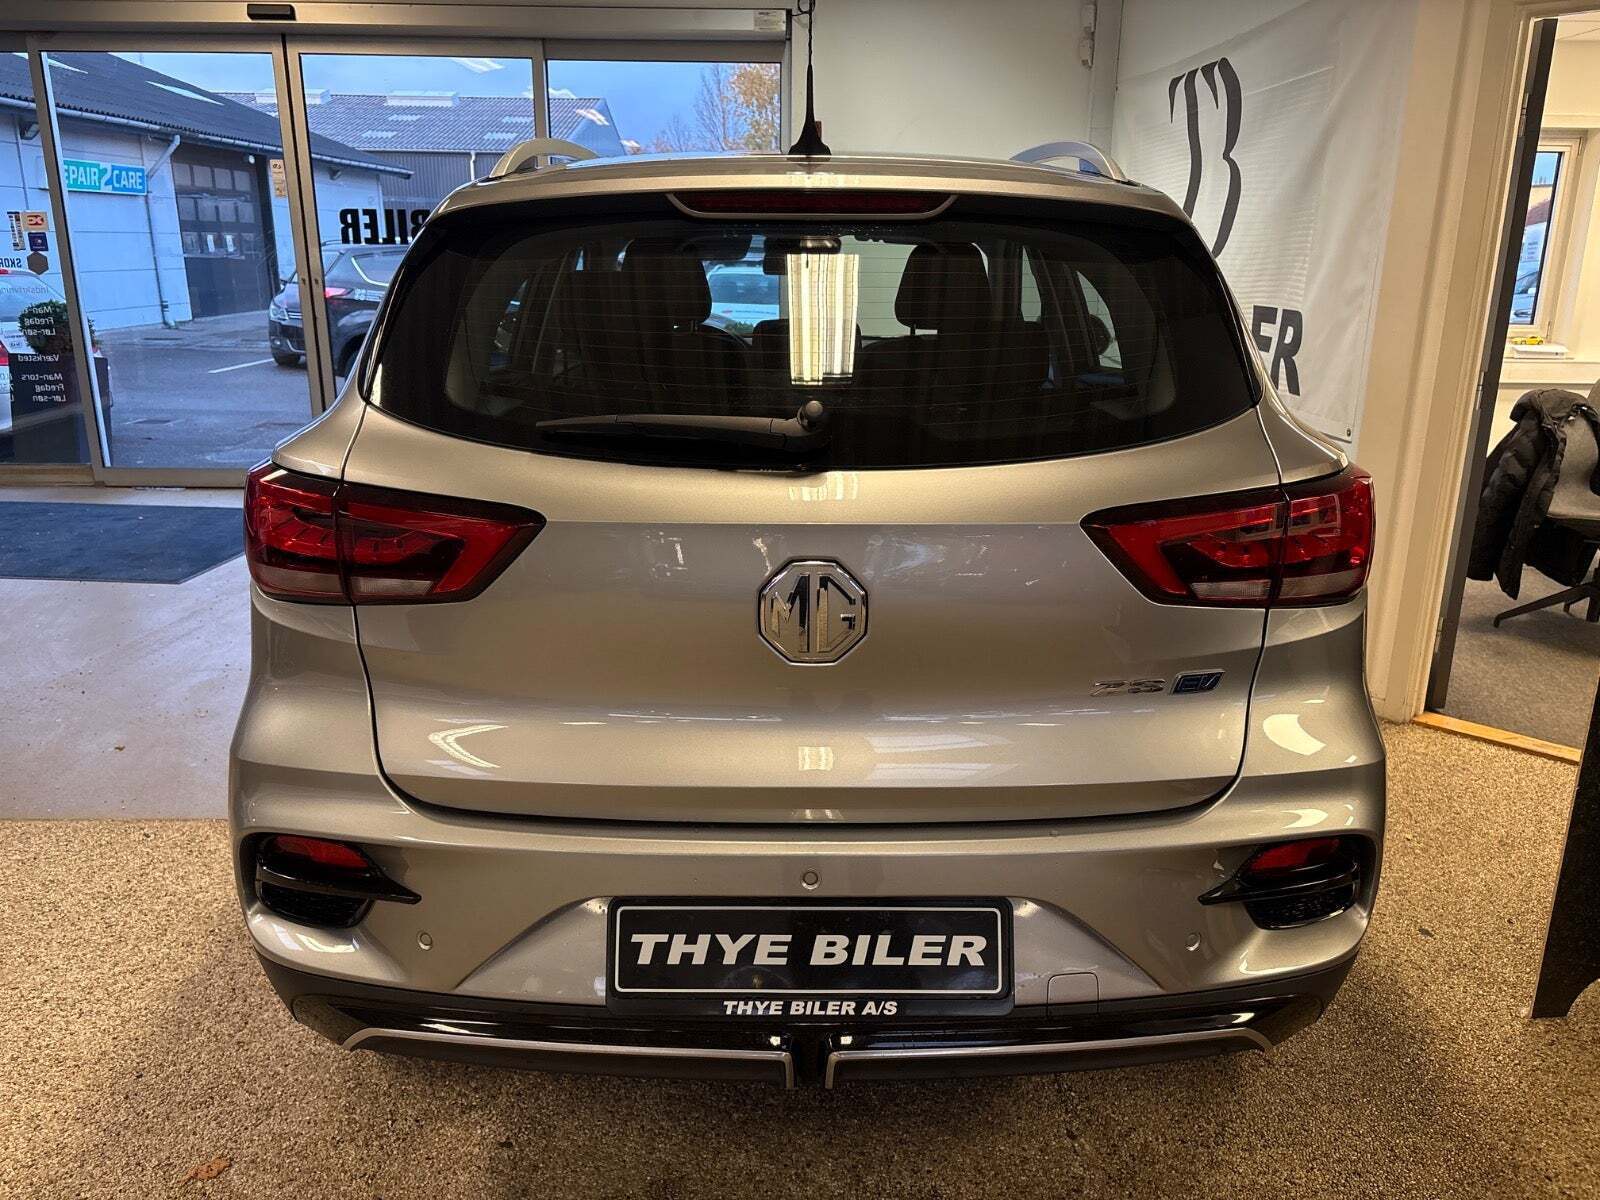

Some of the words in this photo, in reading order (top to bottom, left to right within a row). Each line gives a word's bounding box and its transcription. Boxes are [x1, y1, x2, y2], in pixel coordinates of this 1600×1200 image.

[770, 572, 857, 654] MG
[630, 934, 792, 965] THYE
[809, 934, 987, 966] BILER
[723, 1000, 783, 1016] THYE
[790, 1000, 856, 1016] BILER
[863, 1000, 898, 1016] A/S
